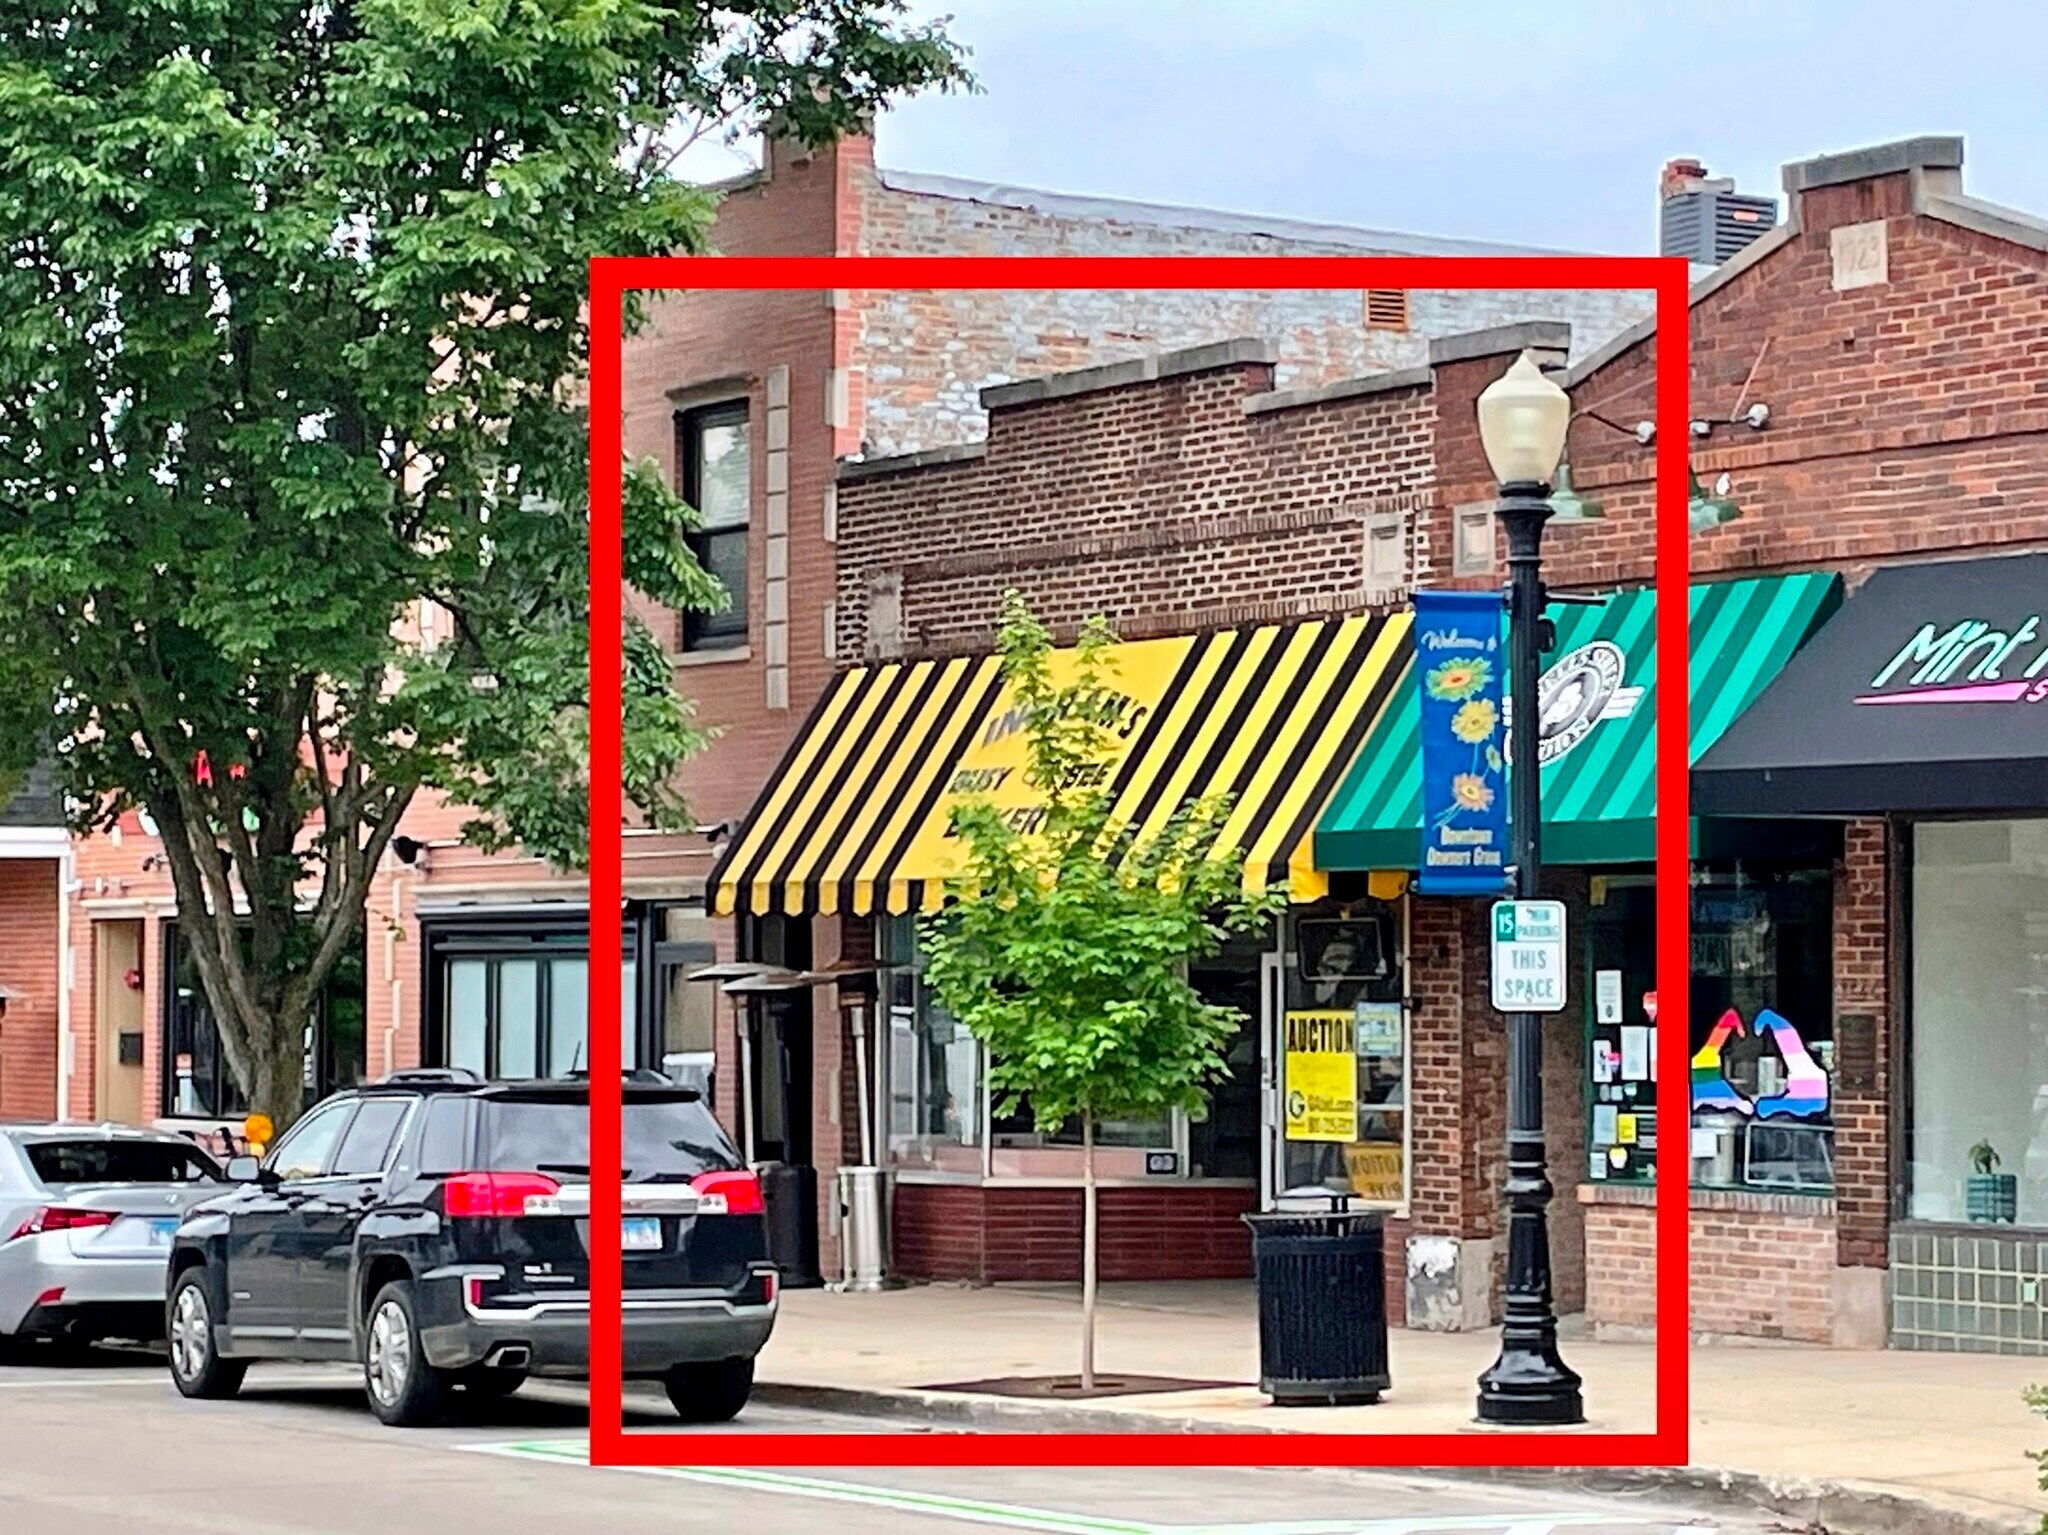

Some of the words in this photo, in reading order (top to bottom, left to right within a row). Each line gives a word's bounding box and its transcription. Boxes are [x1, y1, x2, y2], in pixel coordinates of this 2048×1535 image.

[1870, 614, 2041, 689] Mint
[1497, 913, 1514, 935] 15
[1511, 949, 1547, 970] THIS
[1504, 978, 1554, 999] SPACE
[1288, 1017, 1354, 1053] AUCTION
